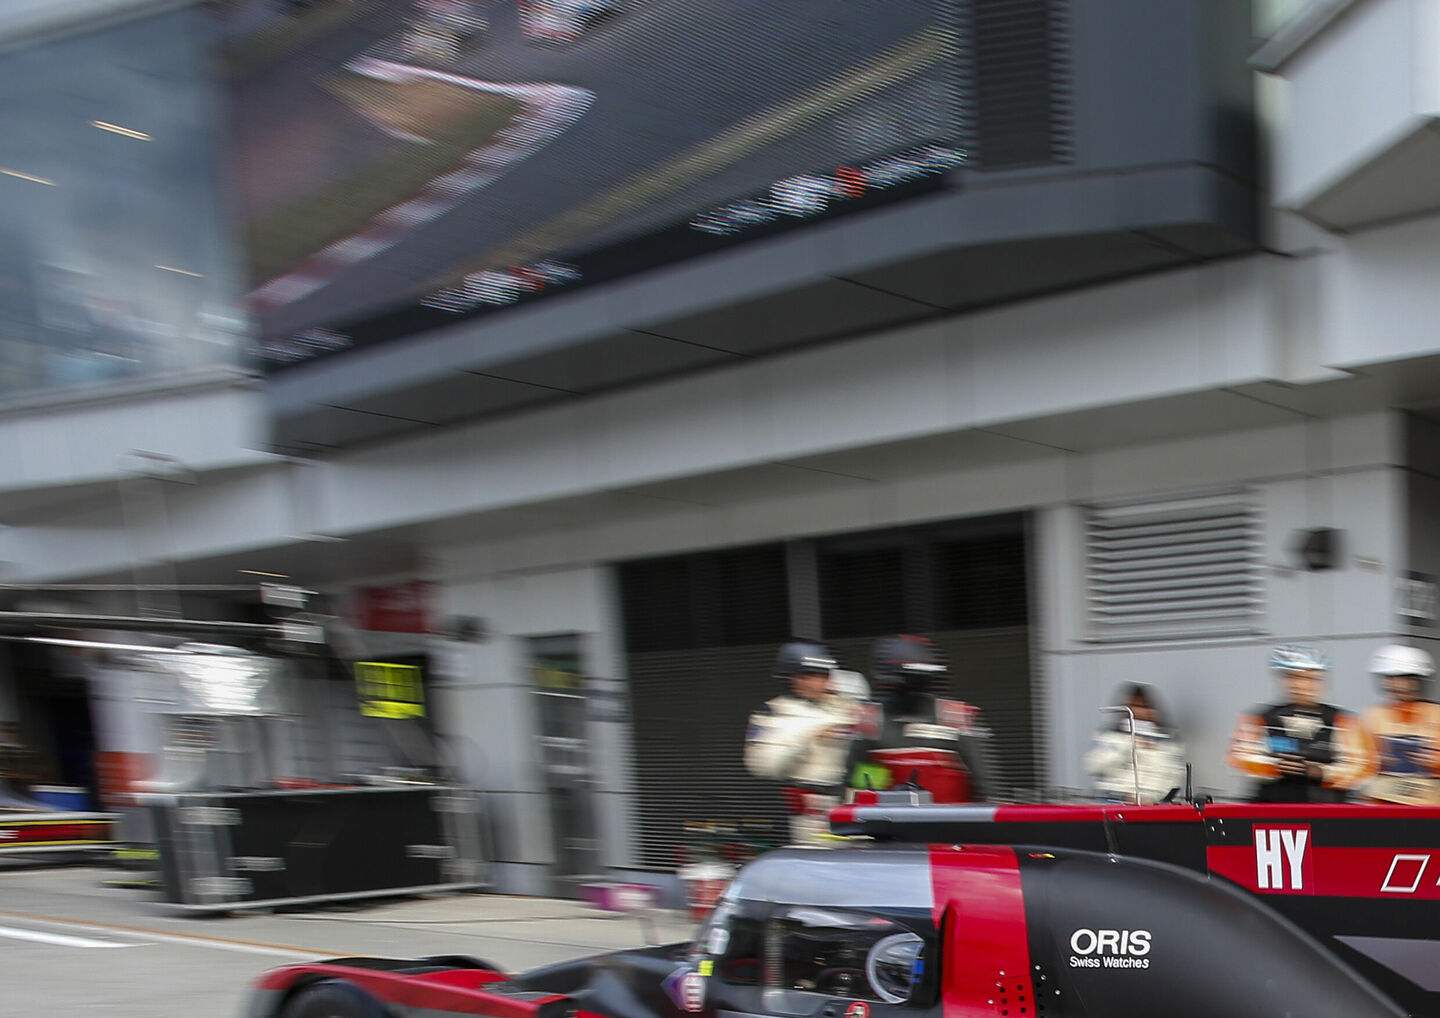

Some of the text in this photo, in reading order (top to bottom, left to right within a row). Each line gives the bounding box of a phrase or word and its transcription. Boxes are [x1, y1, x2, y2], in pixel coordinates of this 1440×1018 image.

[1256, 829, 1306, 890] HY
[1070, 928, 1152, 956] ORIS
[1069, 956, 1150, 970] Swiss Watches
